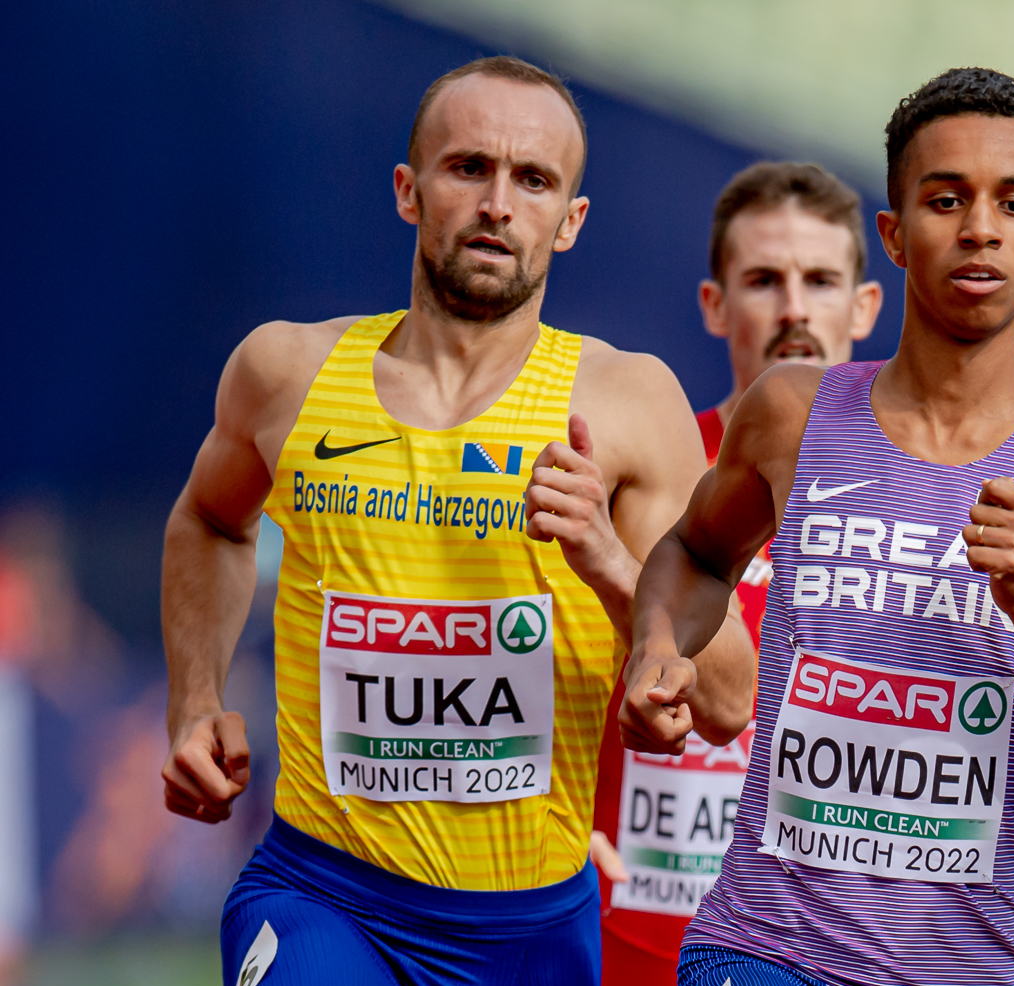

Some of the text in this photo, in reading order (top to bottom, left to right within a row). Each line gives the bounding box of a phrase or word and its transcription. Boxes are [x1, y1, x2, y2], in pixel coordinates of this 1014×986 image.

[294, 471, 529, 539] Bosnia and Herzegovi
[800, 514, 973, 571] GREA
[331, 604, 487, 649] SPAR
[345, 672, 525, 726] TUKA
[795, 662, 949, 724] SPAR
[369, 740, 374, 757] I
[380, 740, 423, 757] RUN
[777, 728, 997, 807] ROWDEN
[340, 761, 536, 793] MUNICH 2022
[630, 787, 740, 841] DE AR
[811, 803, 817, 820] I
[823, 805, 868, 828] RUN
[776, 821, 980, 874] MUNICH 2022
[630, 873, 706, 905] MUNI
